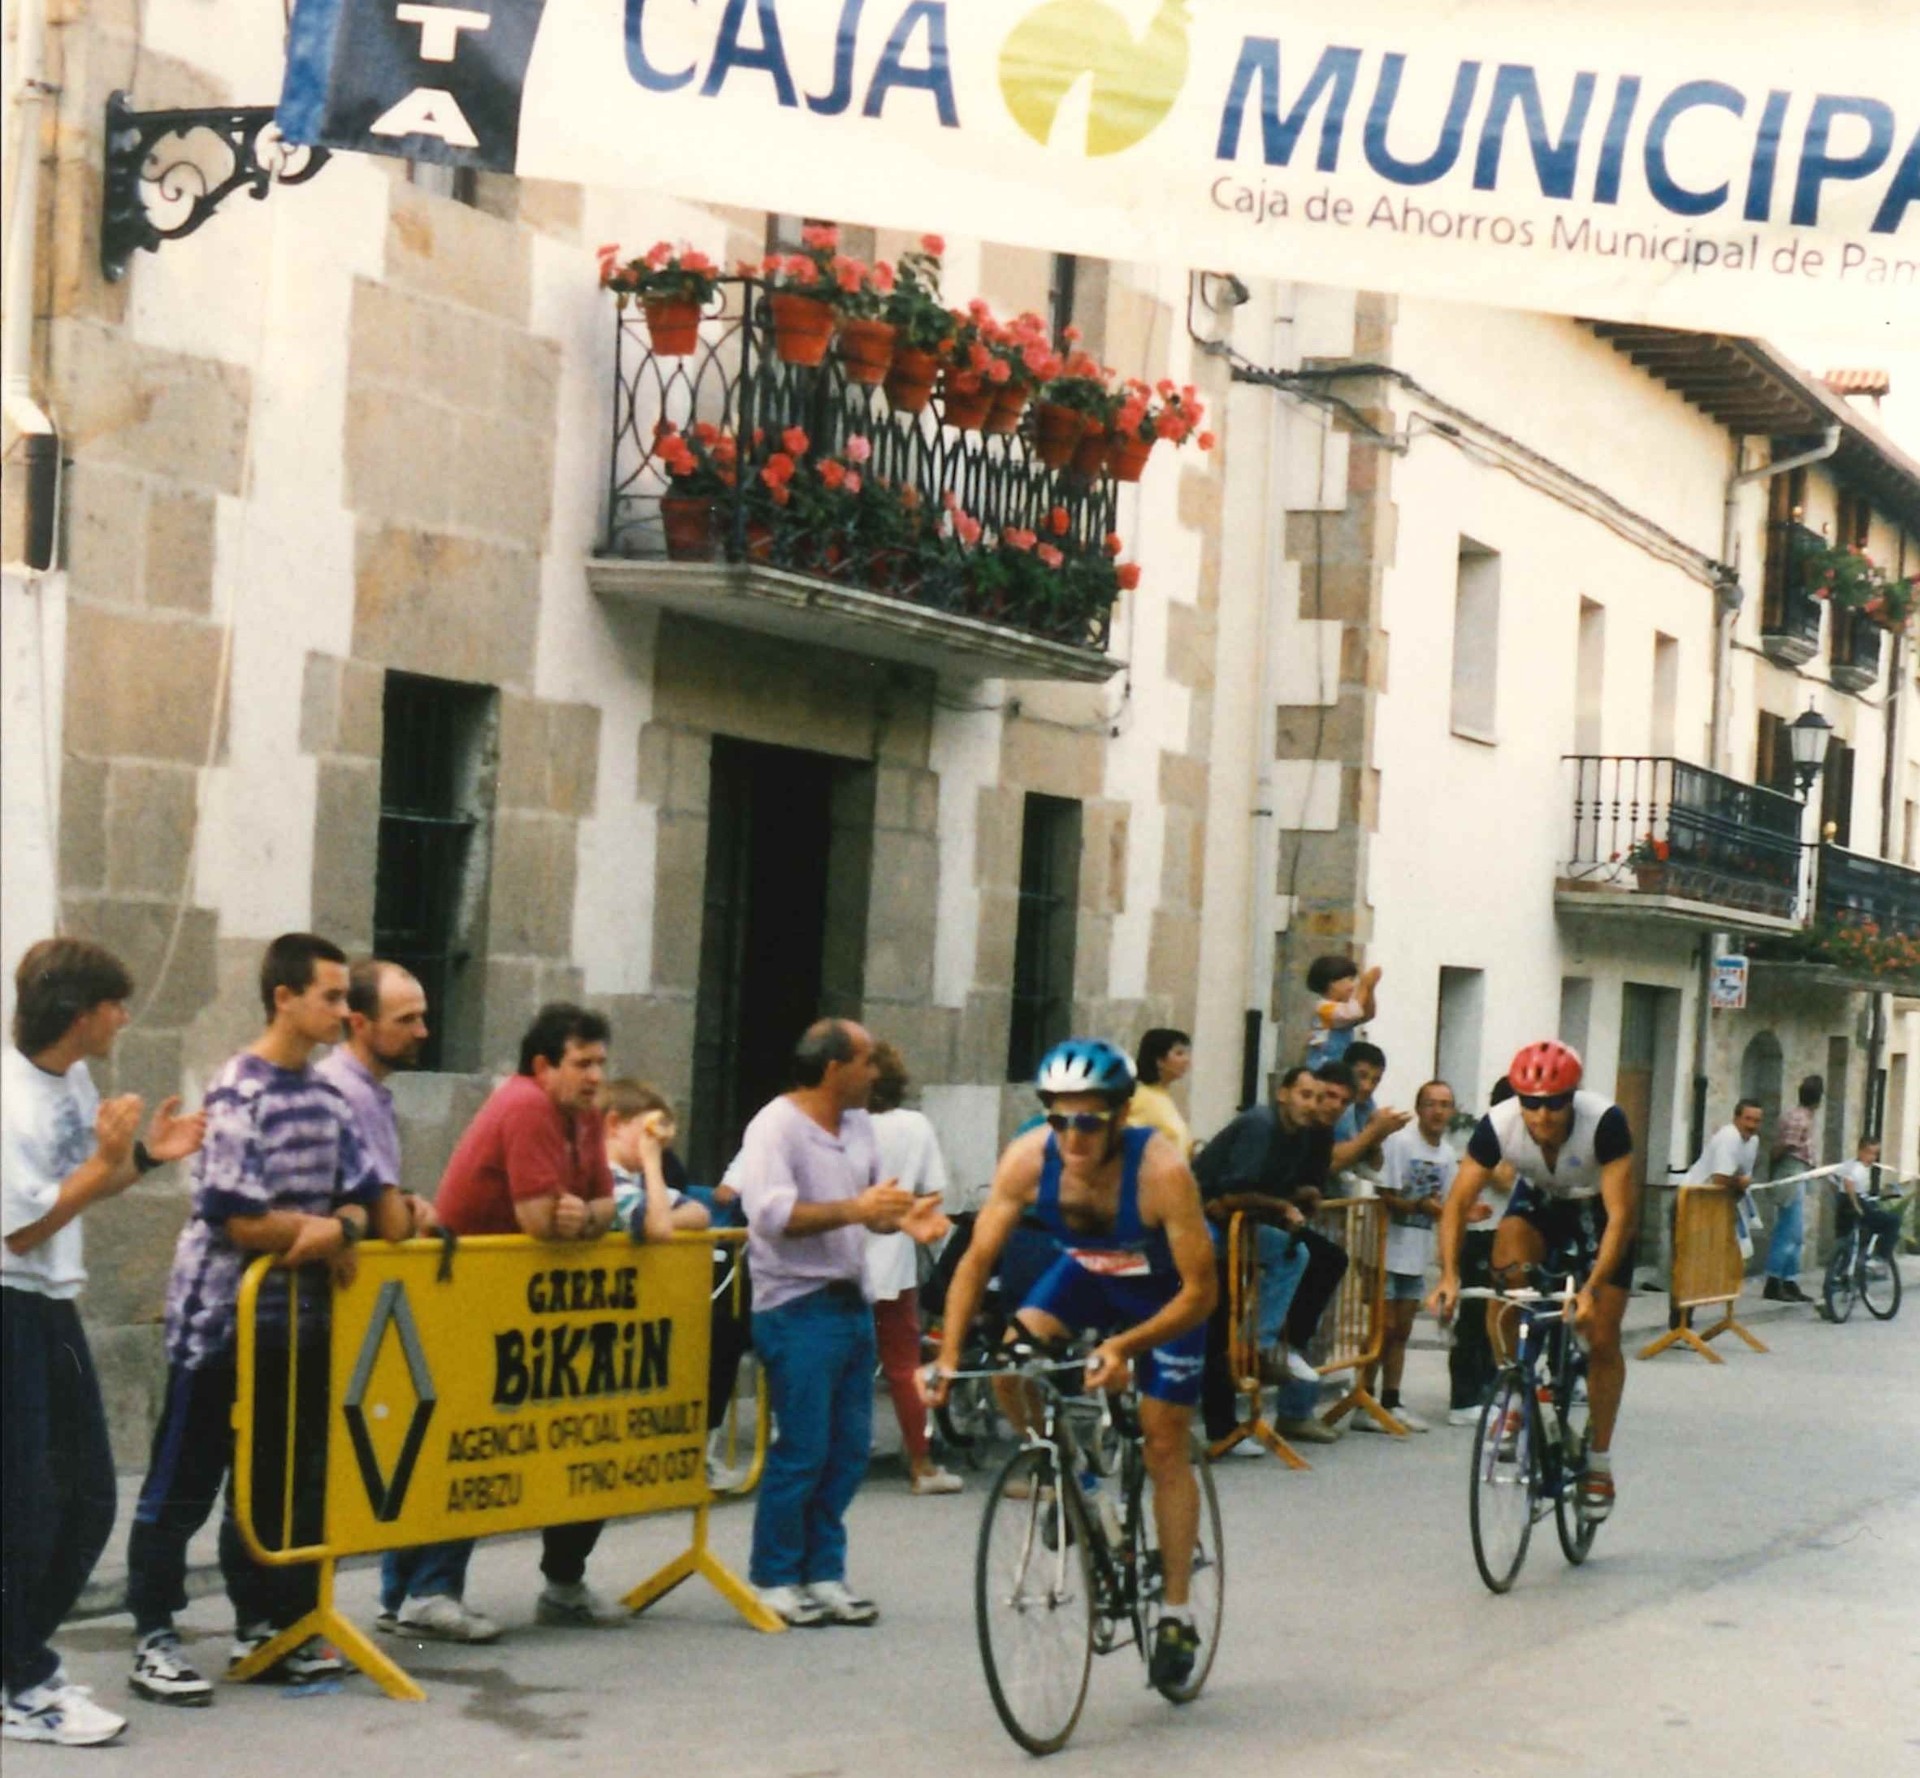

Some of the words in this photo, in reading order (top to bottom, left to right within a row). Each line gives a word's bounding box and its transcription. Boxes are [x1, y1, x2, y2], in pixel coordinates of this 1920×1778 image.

[624, 0, 961, 128] CAJA
[1210, 176, 1290, 224] Caja
[1304, 187, 1354, 226] de
[1367, 195, 1534, 247] Ahorros
[1550, 214, 1759, 273] Municipal
[1772, 238, 1825, 278] de
[527, 1267, 638, 1314] GARAJE
[447, 1422, 540, 1463] AGENCIA
[549, 1411, 622, 1450] OFICIAL
[627, 1400, 703, 1440] RENAULT
[447, 1472, 523, 1512] ARBIZU
